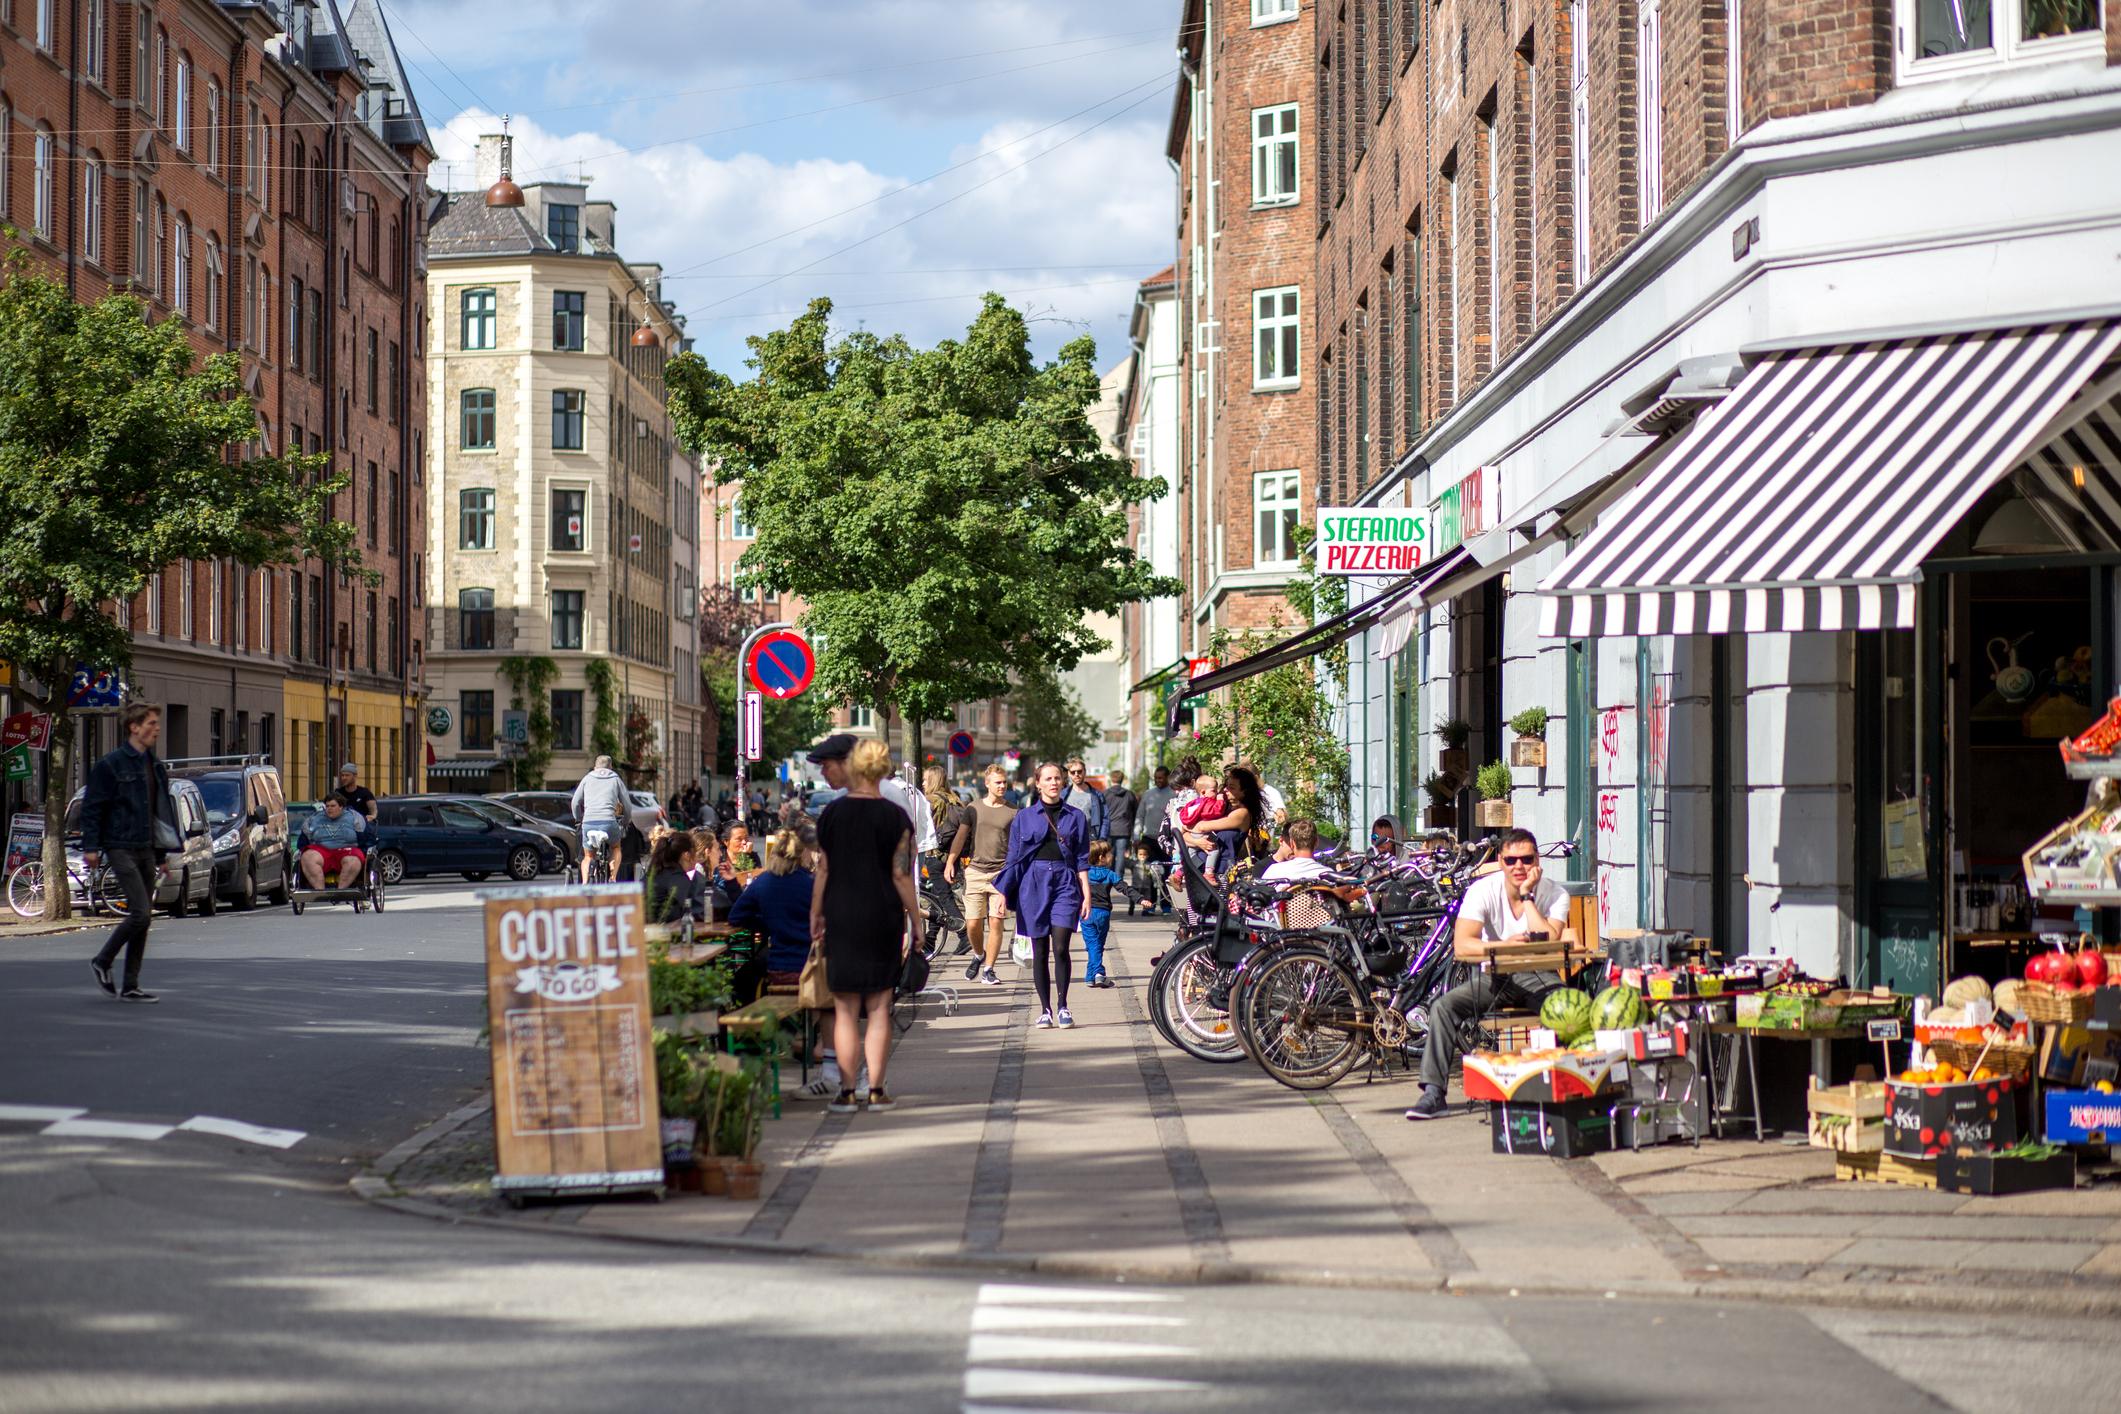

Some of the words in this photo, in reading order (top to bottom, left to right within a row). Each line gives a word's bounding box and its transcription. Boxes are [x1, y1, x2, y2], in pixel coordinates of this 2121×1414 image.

[1323, 517, 1425, 542] STEFANOS
[1327, 545, 1421, 570] PIZZERIA
[73, 670, 113, 693] 30
[5, 731, 26, 740] LOTTO
[500, 904, 638, 962] COFFEE
[540, 977, 565, 995] TO
[571, 977, 597, 994] GO
